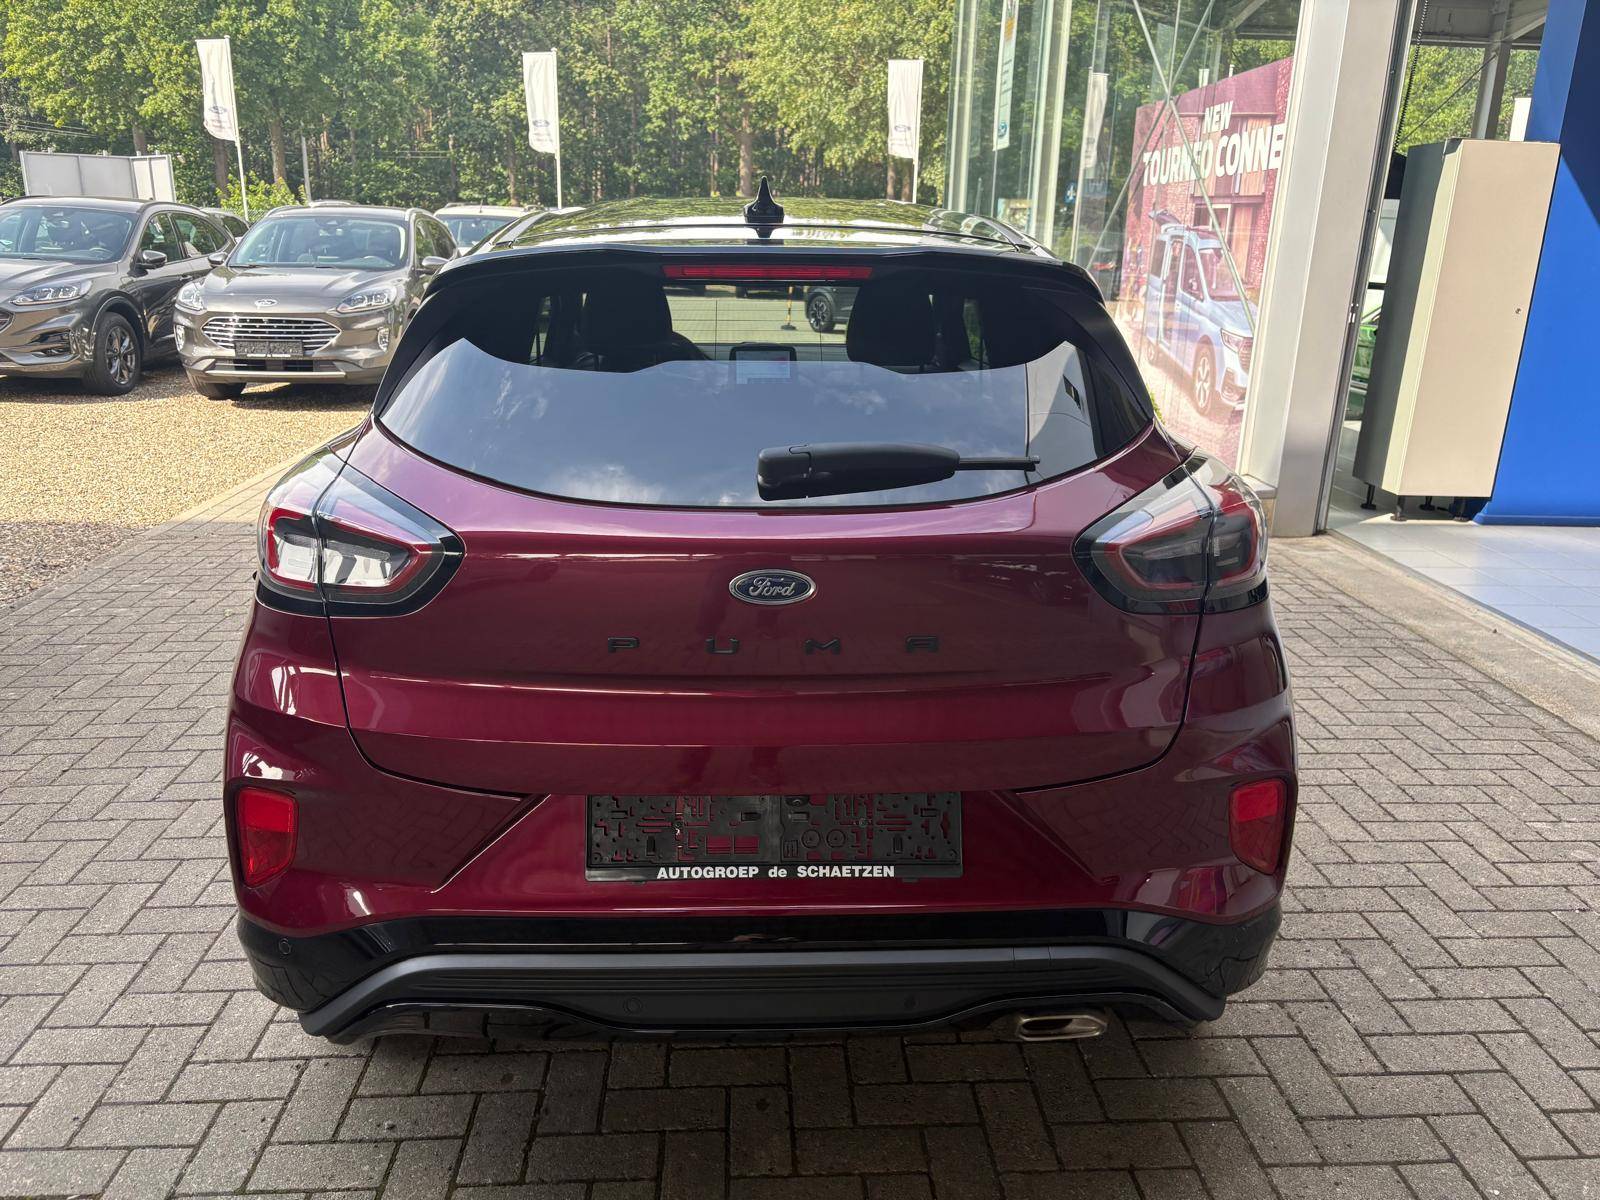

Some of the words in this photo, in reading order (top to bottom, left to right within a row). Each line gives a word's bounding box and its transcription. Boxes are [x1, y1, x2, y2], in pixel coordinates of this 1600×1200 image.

[1203, 101, 1233, 133] NEW
[1143, 139, 1214, 186] TOURNEO
[748, 576, 796, 596] Ford
[607, 635, 940, 655] PUMA
[656, 866, 759, 879] AUTOGROEP
[768, 866, 788, 878] de
[797, 865, 895, 878] SCHAETZEN
